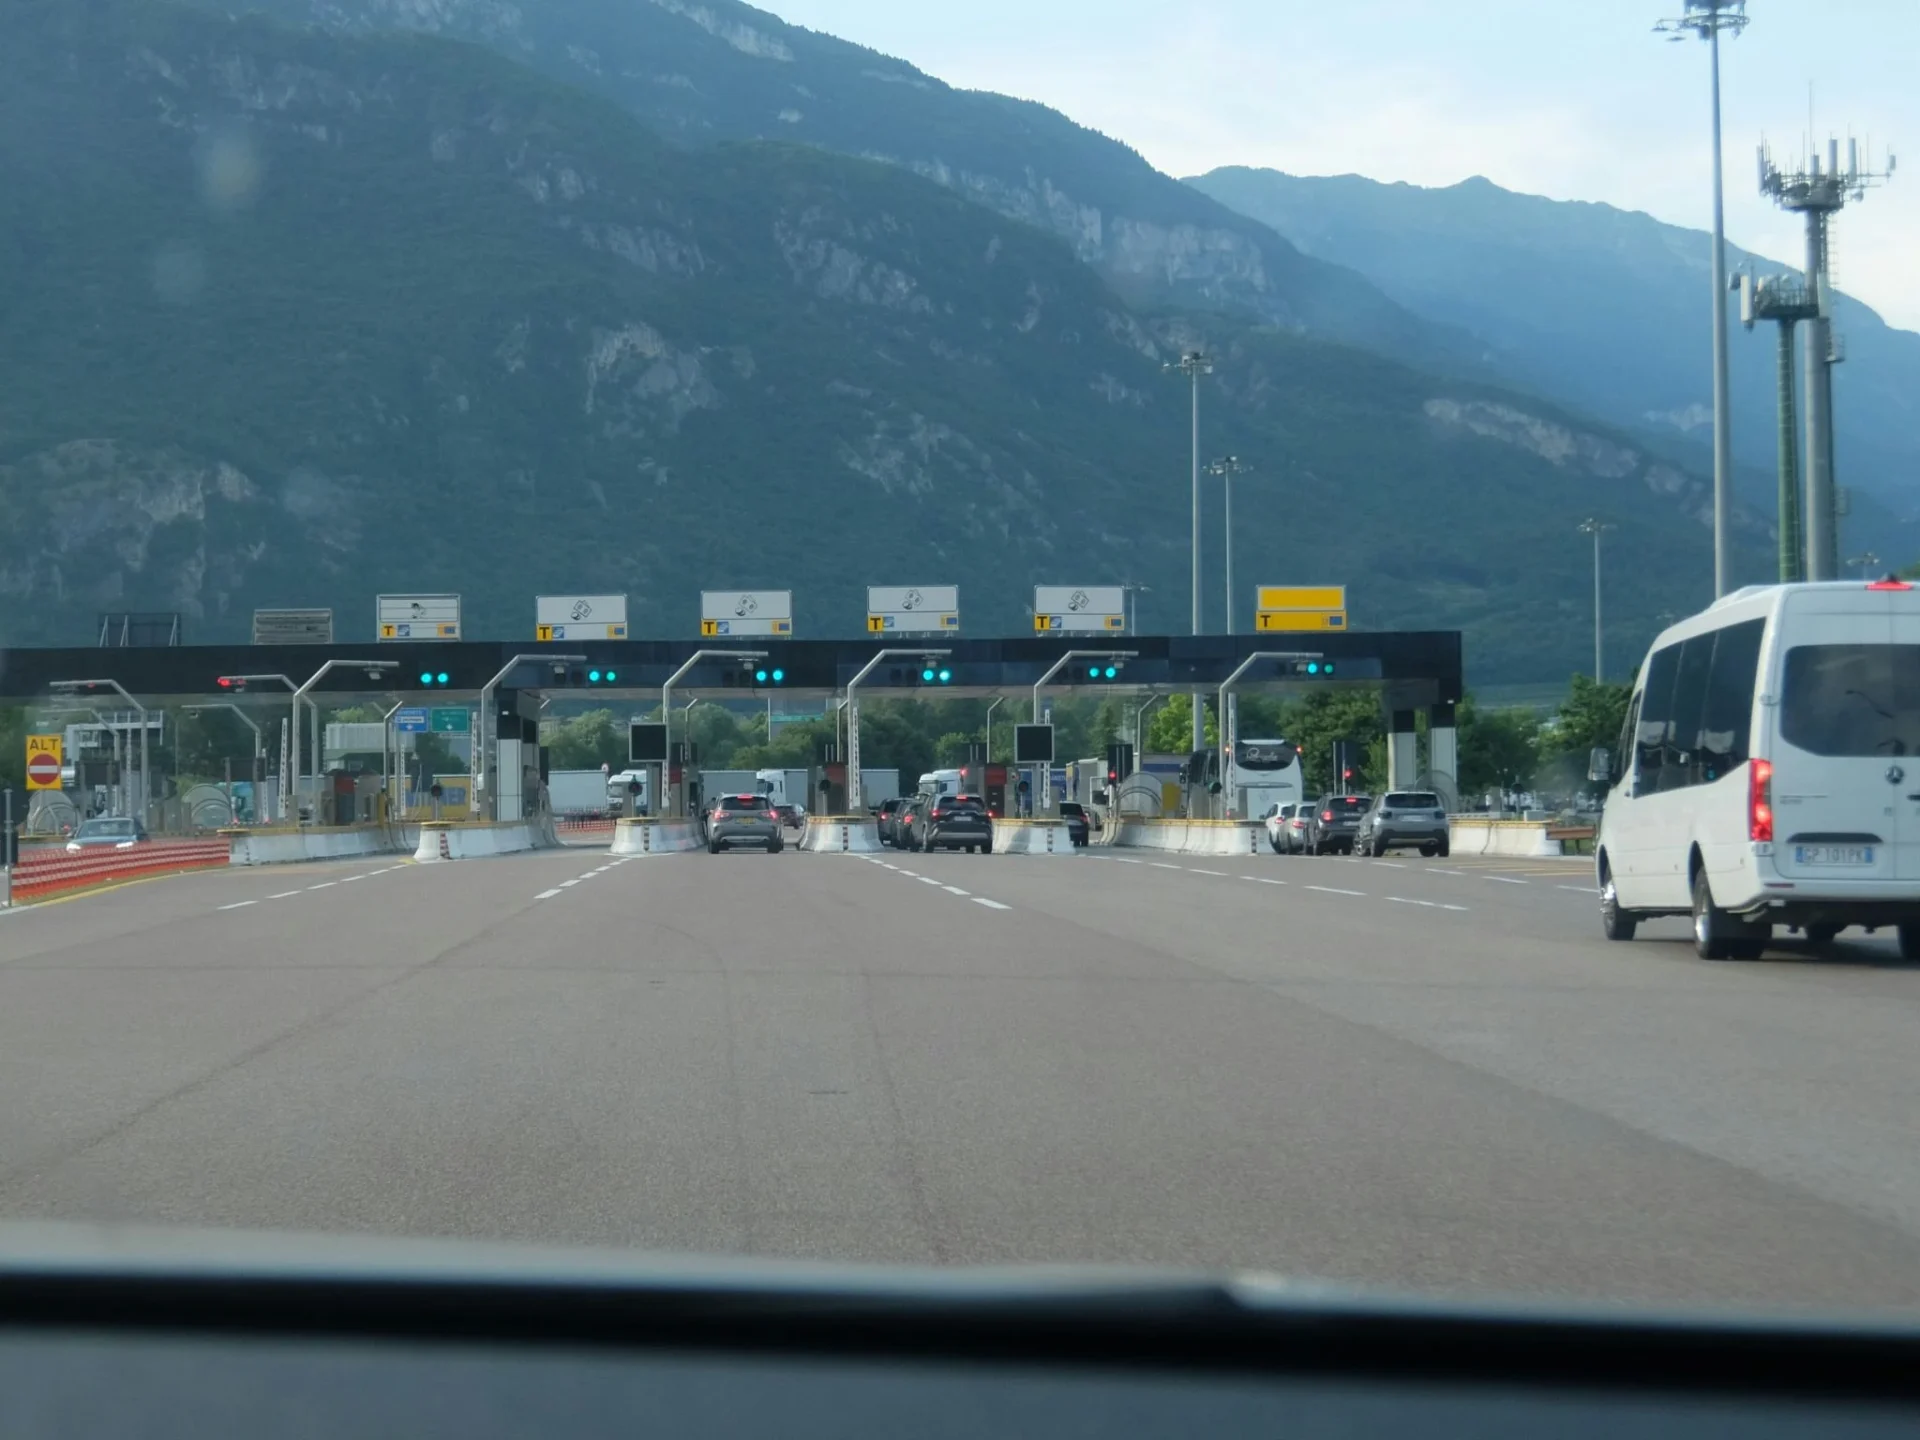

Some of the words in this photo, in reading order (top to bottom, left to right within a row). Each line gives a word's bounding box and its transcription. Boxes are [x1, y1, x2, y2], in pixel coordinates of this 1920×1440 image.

[870, 617, 881, 630] T
[1036, 616, 1047, 628] T
[1260, 615, 1271, 627] T
[383, 625, 394, 636] T
[539, 627, 550, 639] T
[704, 621, 714, 634] T
[29, 738, 59, 751] ALT
